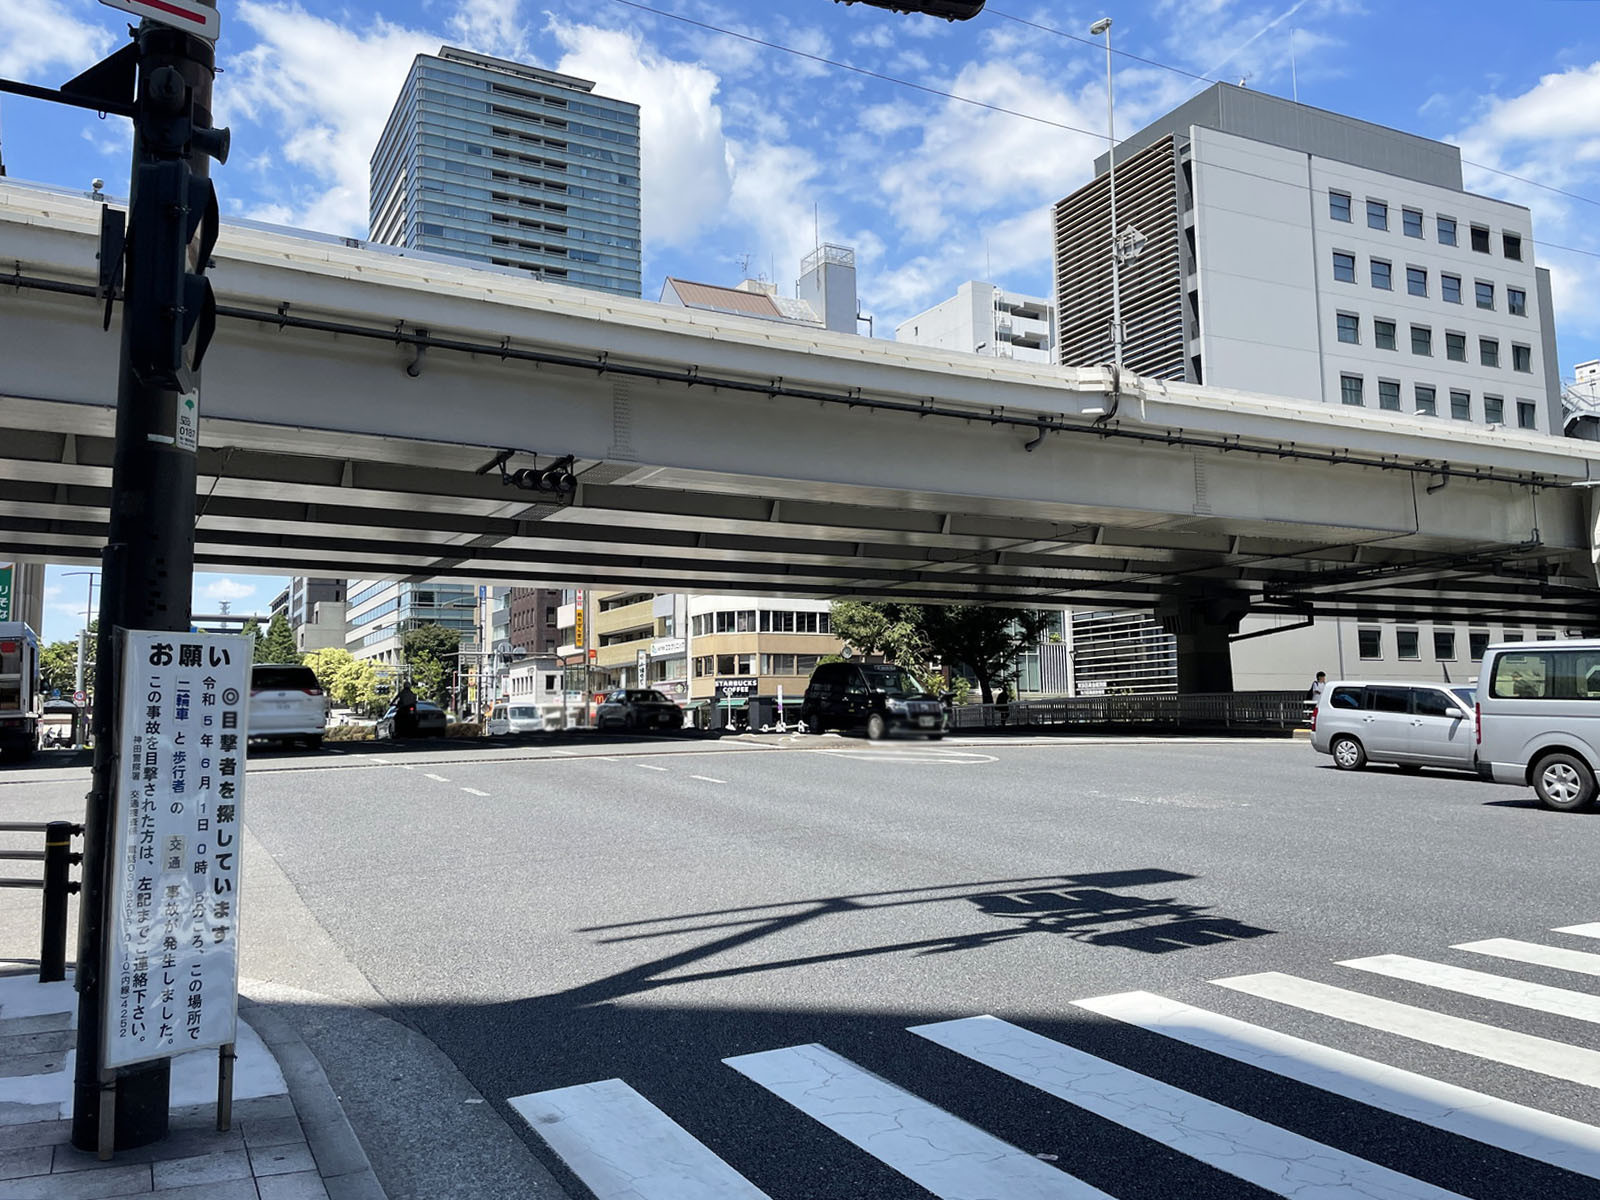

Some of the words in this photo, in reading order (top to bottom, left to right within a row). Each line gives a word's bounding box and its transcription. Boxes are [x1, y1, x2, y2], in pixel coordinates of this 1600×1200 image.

[149, 643, 231, 668] お願い
[715, 679, 758, 688] STARBUCKS
[722, 686, 750, 694] COFFEE
